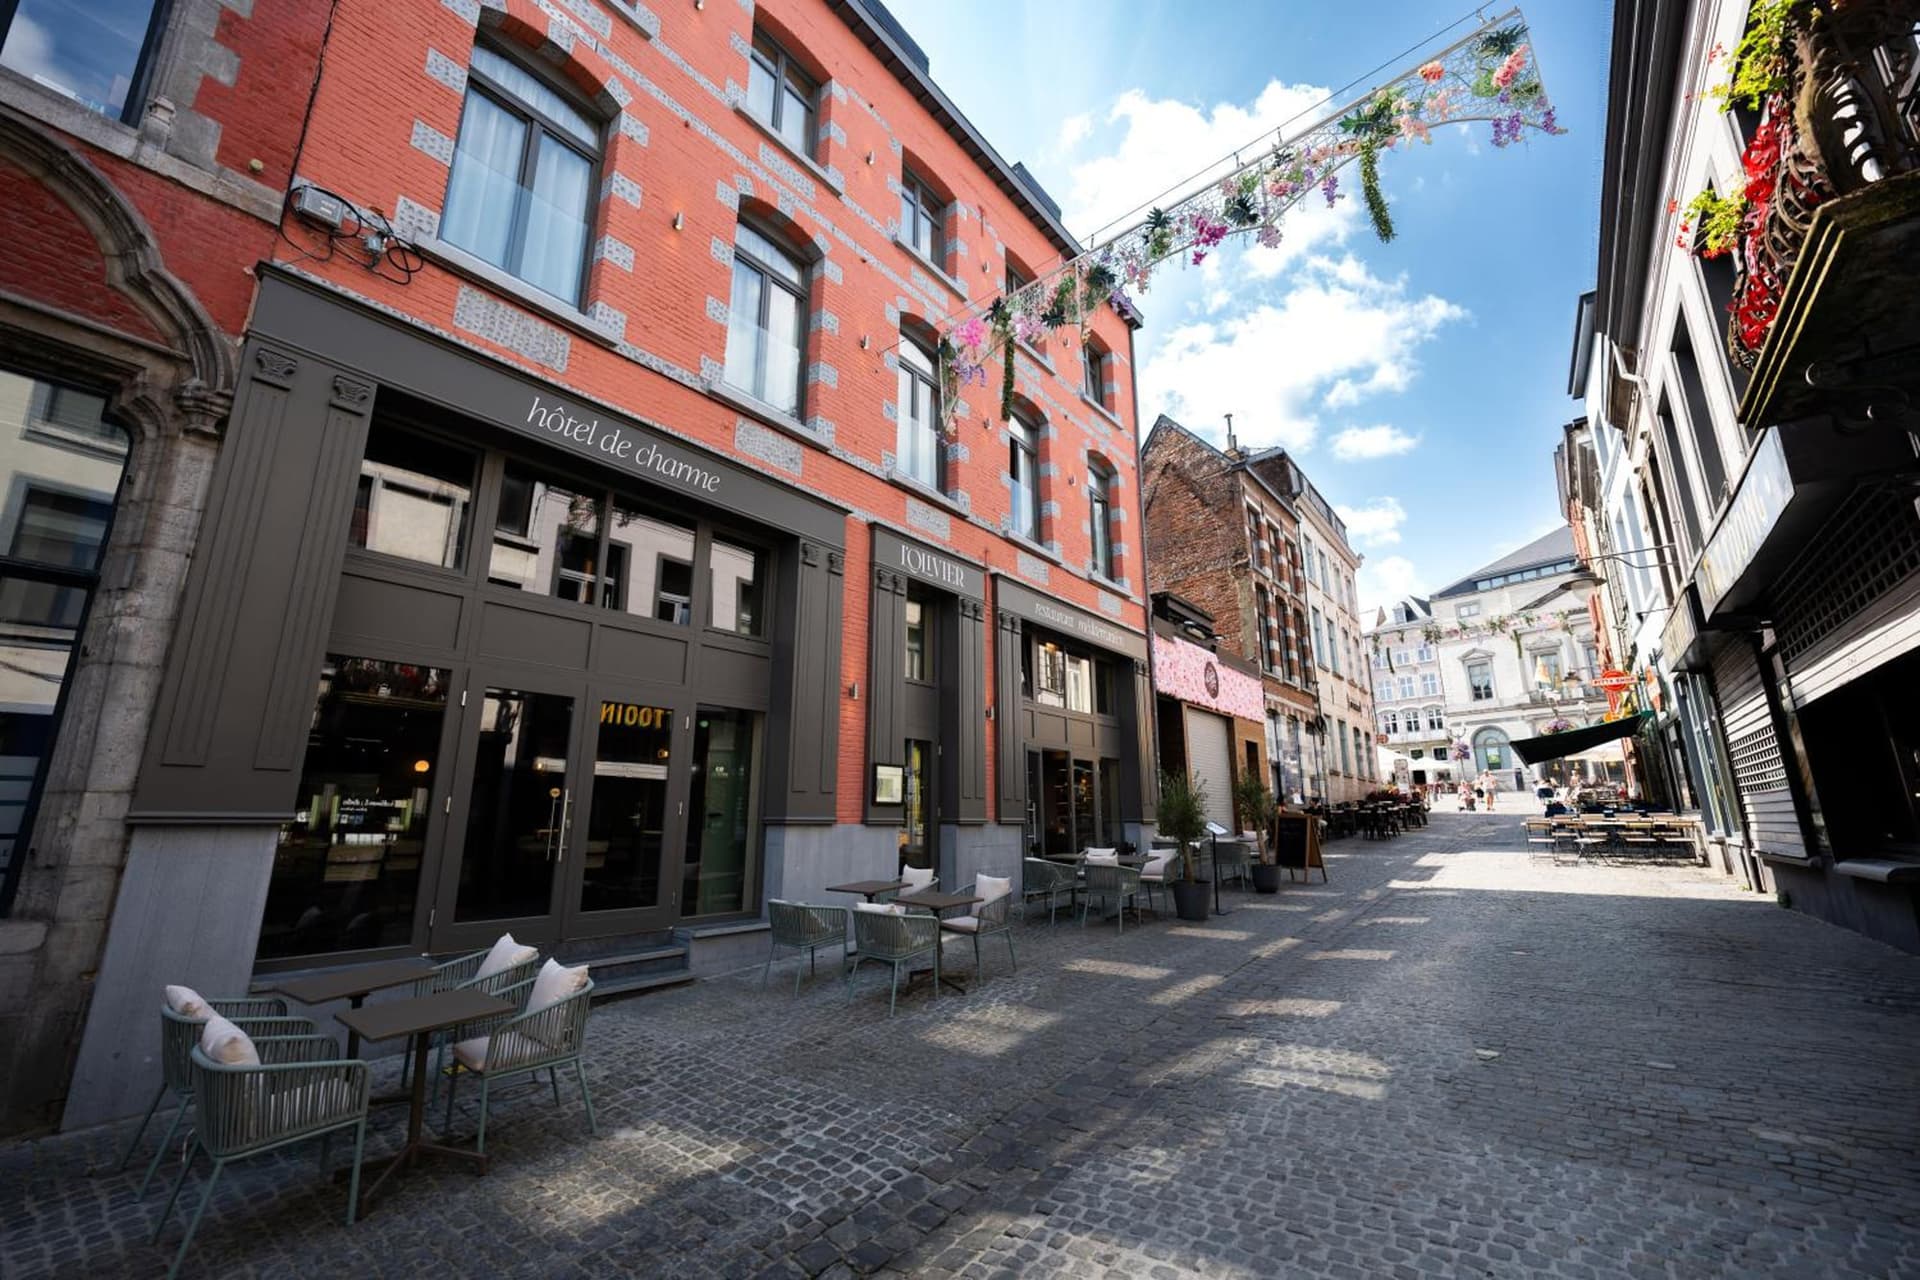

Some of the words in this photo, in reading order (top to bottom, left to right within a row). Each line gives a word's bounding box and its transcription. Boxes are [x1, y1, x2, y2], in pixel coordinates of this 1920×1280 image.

[527, 397, 597, 445] hôtel
[600, 429, 632, 458] de
[635, 444, 720, 492] charme
